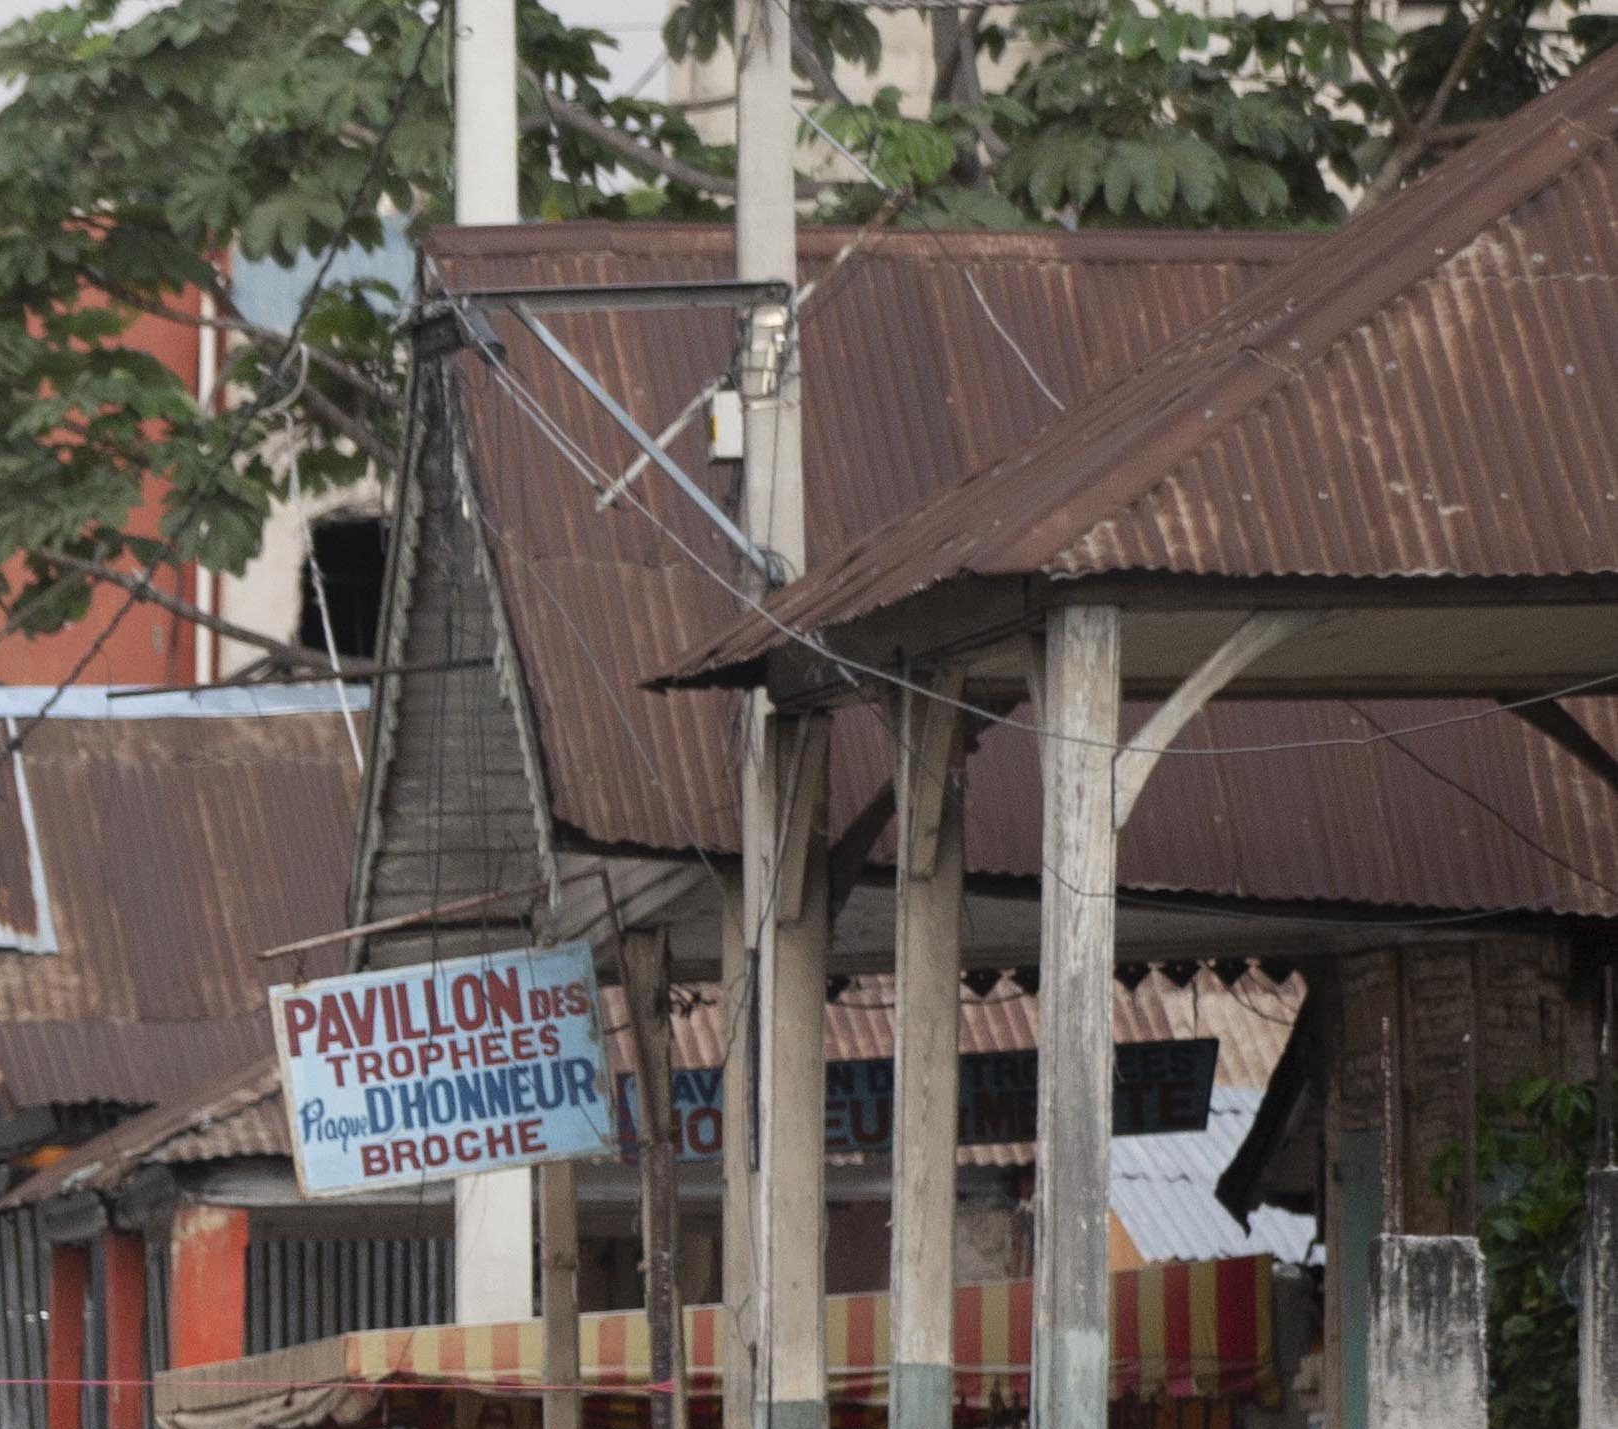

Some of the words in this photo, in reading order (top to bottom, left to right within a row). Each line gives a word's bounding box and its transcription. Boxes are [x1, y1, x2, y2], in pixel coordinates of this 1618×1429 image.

[283, 966, 524, 1057] PAVILLON
[528, 981, 591, 1022] DES
[326, 1024, 561, 1087] TROPHEES
[361, 1119, 548, 1177] BROCHE
